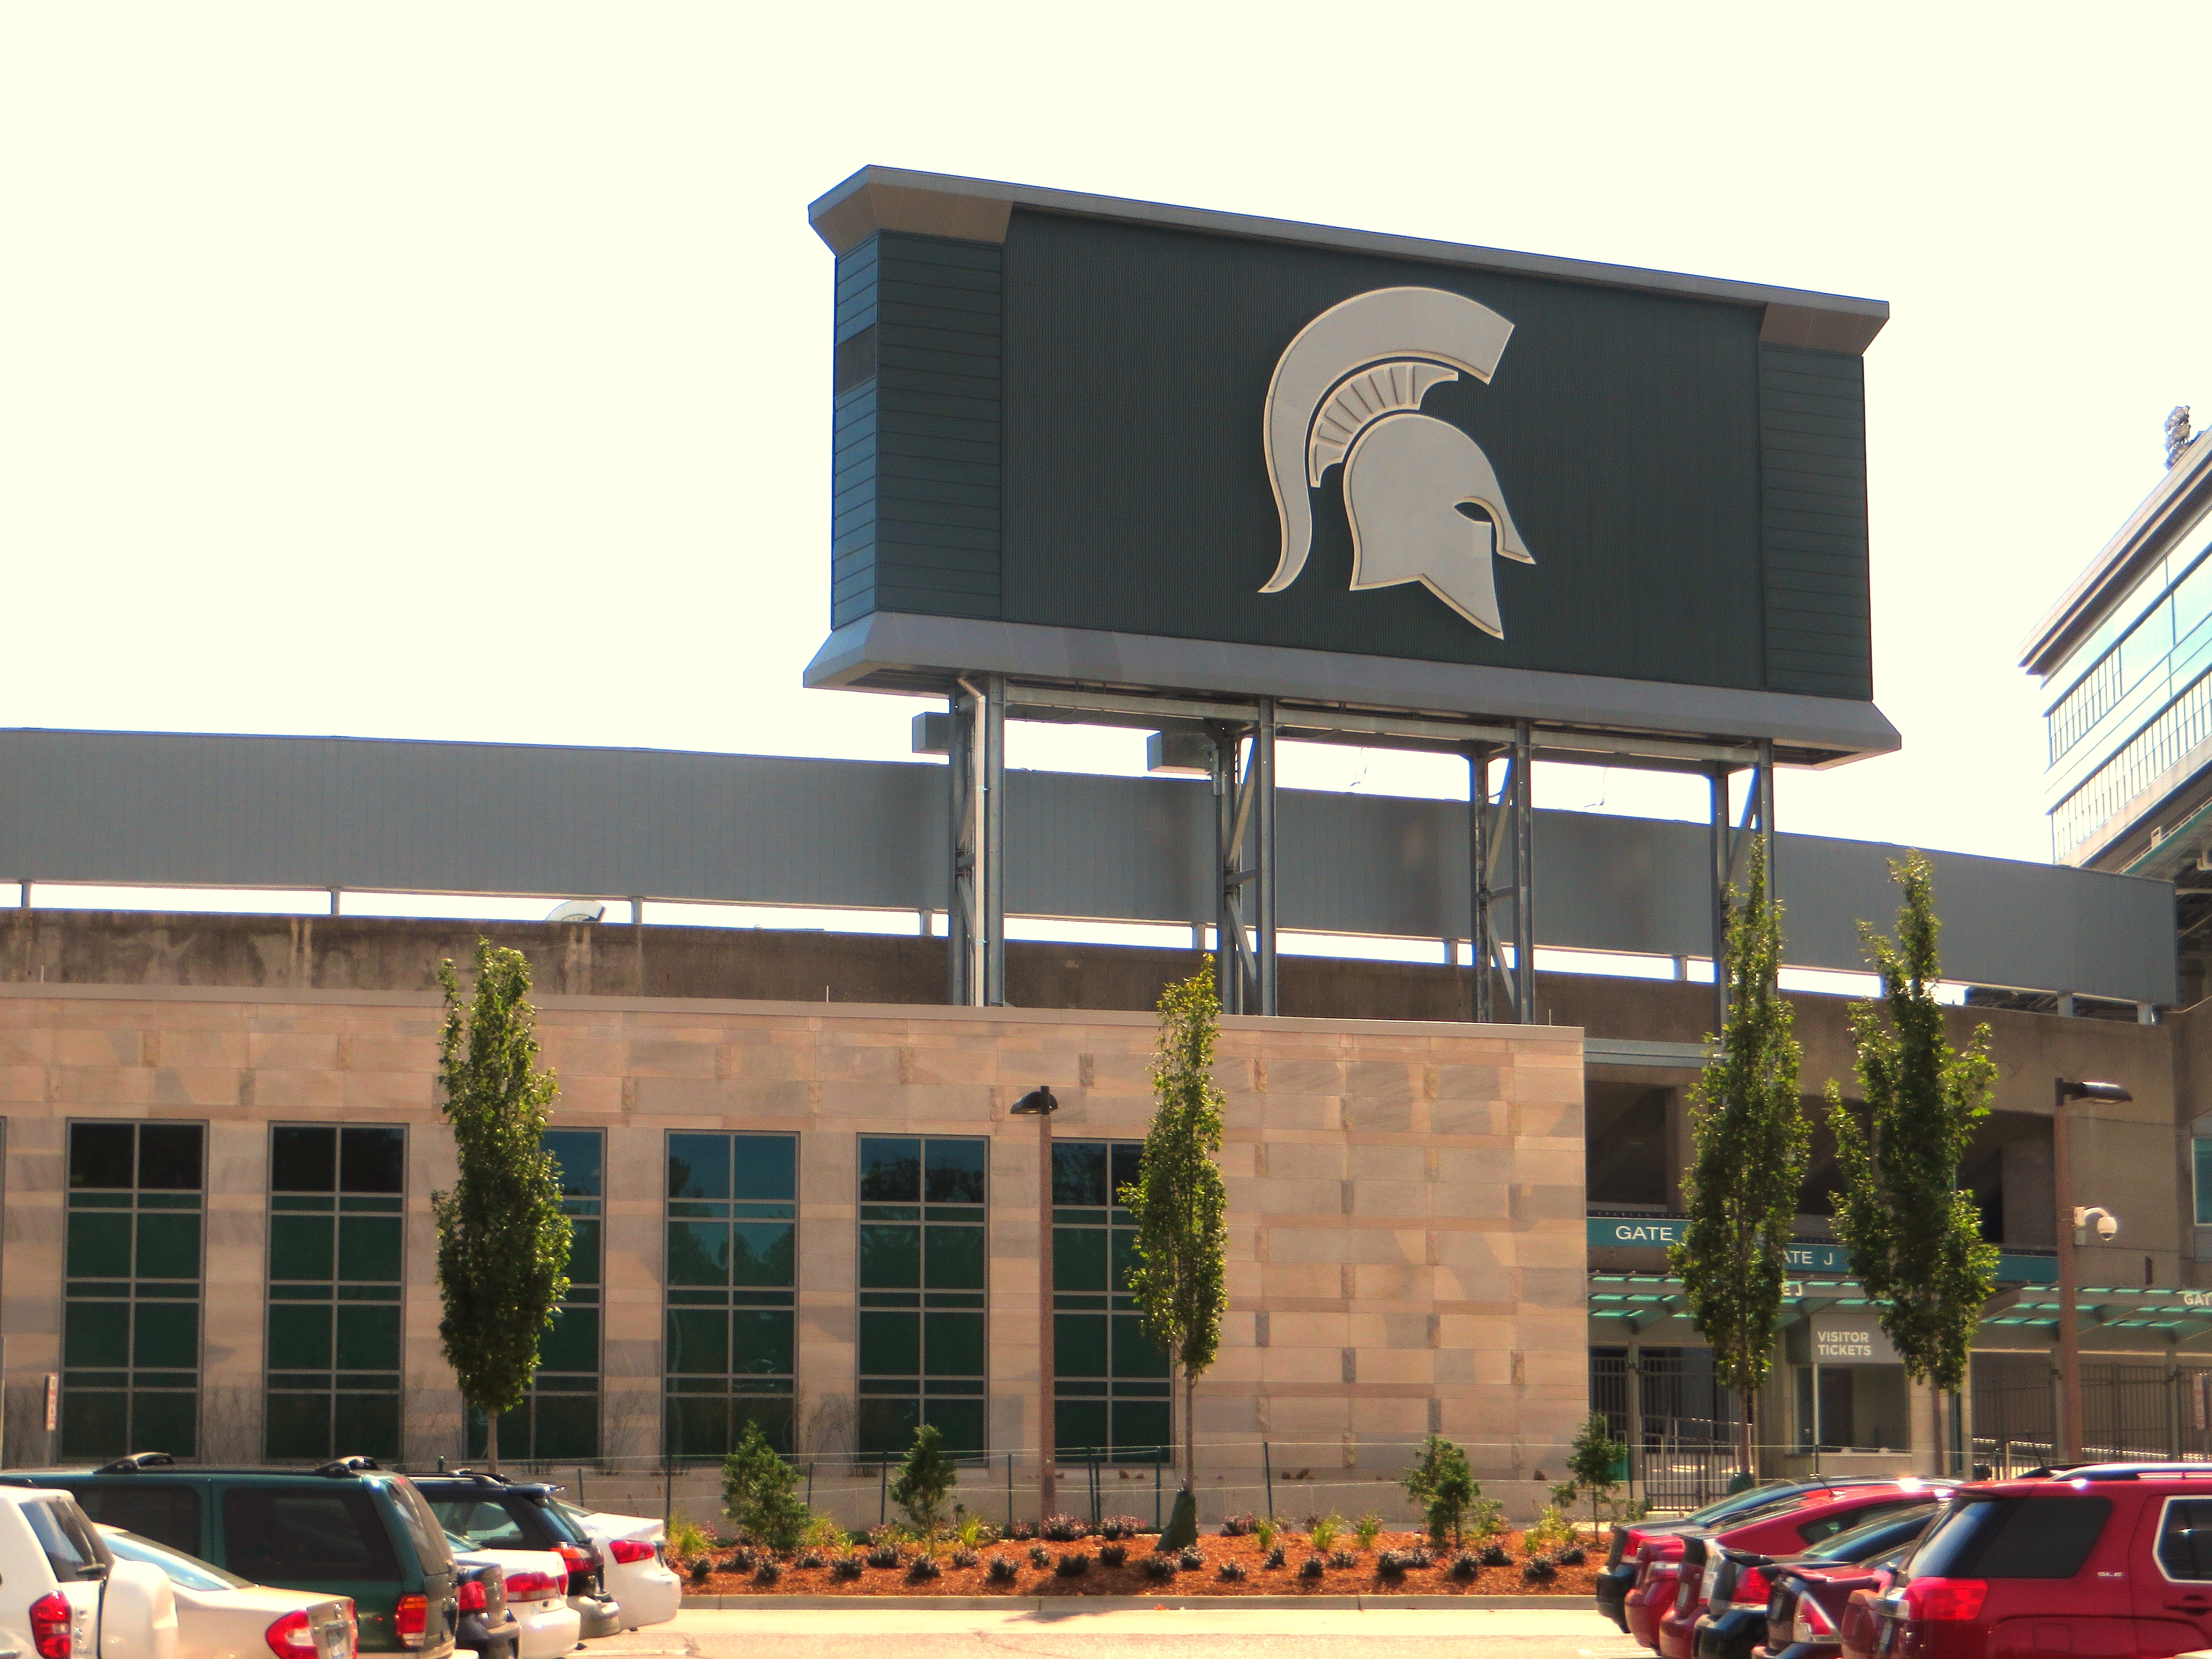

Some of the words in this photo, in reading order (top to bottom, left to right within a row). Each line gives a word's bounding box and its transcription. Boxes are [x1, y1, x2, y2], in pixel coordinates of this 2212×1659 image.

[1615, 1225, 1673, 1241] GATE
[1782, 1249, 1813, 1264] ATE
[1823, 1252, 1833, 1265] J
[1795, 1284, 1803, 1297] J
[1817, 1331, 1869, 1343] VISITOR
[1817, 1344, 1872, 1356] TICKETS
